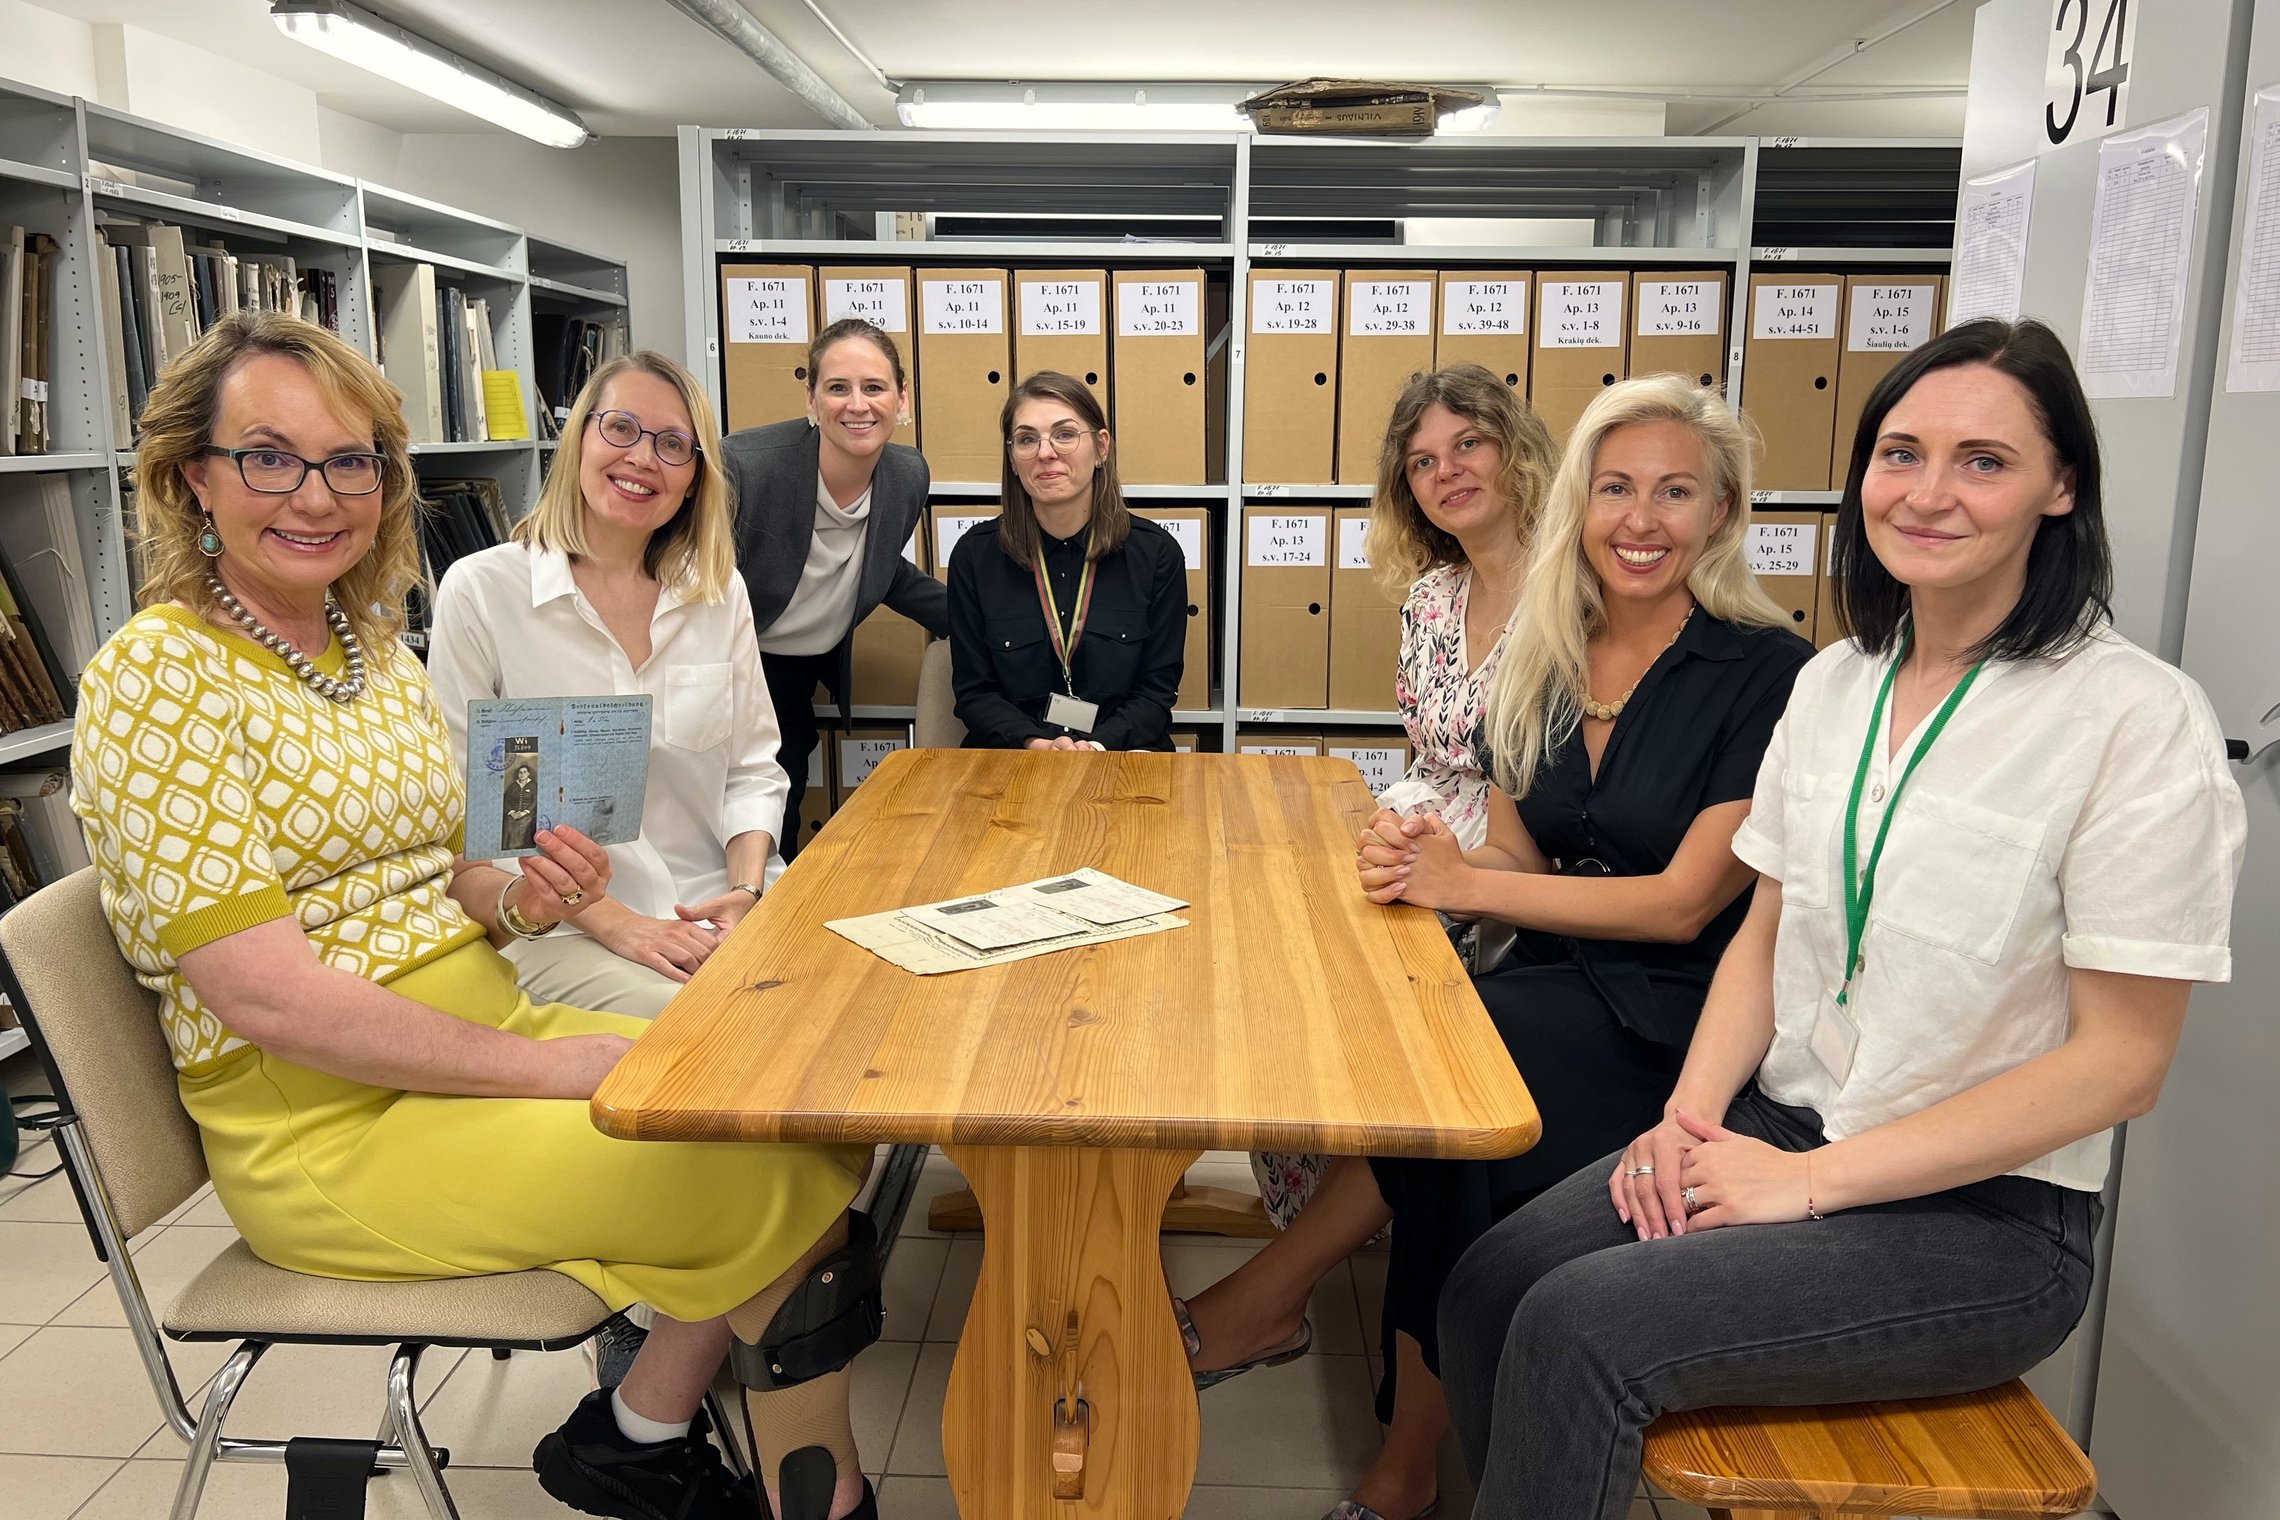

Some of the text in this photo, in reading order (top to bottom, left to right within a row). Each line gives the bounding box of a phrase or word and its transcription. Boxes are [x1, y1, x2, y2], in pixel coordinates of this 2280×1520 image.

[2046, 0, 2128, 145] 34
[1337, 113, 1382, 122] VILNIAUS
[748, 282, 785, 291] F. 1671
[846, 283, 884, 293] F. 1671
[946, 284, 984, 294] F. 1671
[1042, 285, 1079, 295] F. 1671
[1142, 286, 1180, 296] F. 1671
[1277, 284, 1315, 293] F. 1671
[1372, 286, 1410, 295] F. 1671
[1469, 285, 1508, 295] F. 1671
[1562, 286, 1600, 296] F. 1671
[1660, 285, 1699, 295] F. 1671
[1777, 289, 1816, 299] F. 1671
[1873, 289, 1912, 299] F. 1671
[751, 300, 784, 311] Ap. 11
[849, 301, 883, 312] Ap. 11
[946, 302, 979, 313] Ap. 11
[1044, 303, 1077, 315] Ap. 11
[1141, 304, 1175, 315] Ap. 11
[1275, 301, 1310, 313] Ap. 12
[1373, 303, 1408, 315] Ap. 12
[1467, 303, 1502, 314] Ap. 12
[1564, 303, 1598, 315] Ap. 13
[1662, 303, 1696, 315] Ap. 13
[1777, 307, 1813, 318] Ap. 14
[1873, 307, 1909, 319] Ap. 15
[750, 317, 787, 326] s.v. 1-4
[938, 319, 988, 329] s.v. 10-14
[1036, 320, 1086, 330] s.v. 15-19
[1133, 321, 1184, 331] s.v. 20-23
[1267, 319, 1317, 329] s.v. 19-28
[1386, 321, 1415, 330] 29-38
[1458, 320, 1509, 330] s.v. 39-48
[1583, 321, 1599, 331] 1-8
[1677, 320, 1700, 330] 9-16
[1768, 324, 1819, 334] s.v. 44-51
[1870, 324, 1909, 335] s.v. 1-6
[749, 332, 790, 340] Kauno dek.
[1558, 336, 1602, 345] Krakių dek.
[710, 342, 715, 351] 6
[1866, 338, 1892, 349] Šiaulių
[1733, 353, 1739, 361] 8
[1272, 520, 1308, 528] F. 1671
[1760, 528, 1798, 537] F. 1671
[1270, 536, 1304, 547] Ap. 13
[1757, 545, 1792, 555] Ap. 15
[1283, 552, 1310, 561] 17-24
[1769, 561, 1798, 570] 25-29
[861, 743, 896, 751] F. 1671
[1352, 752, 1388, 760] F. 1671
[1372, 768, 1383, 776] 14
